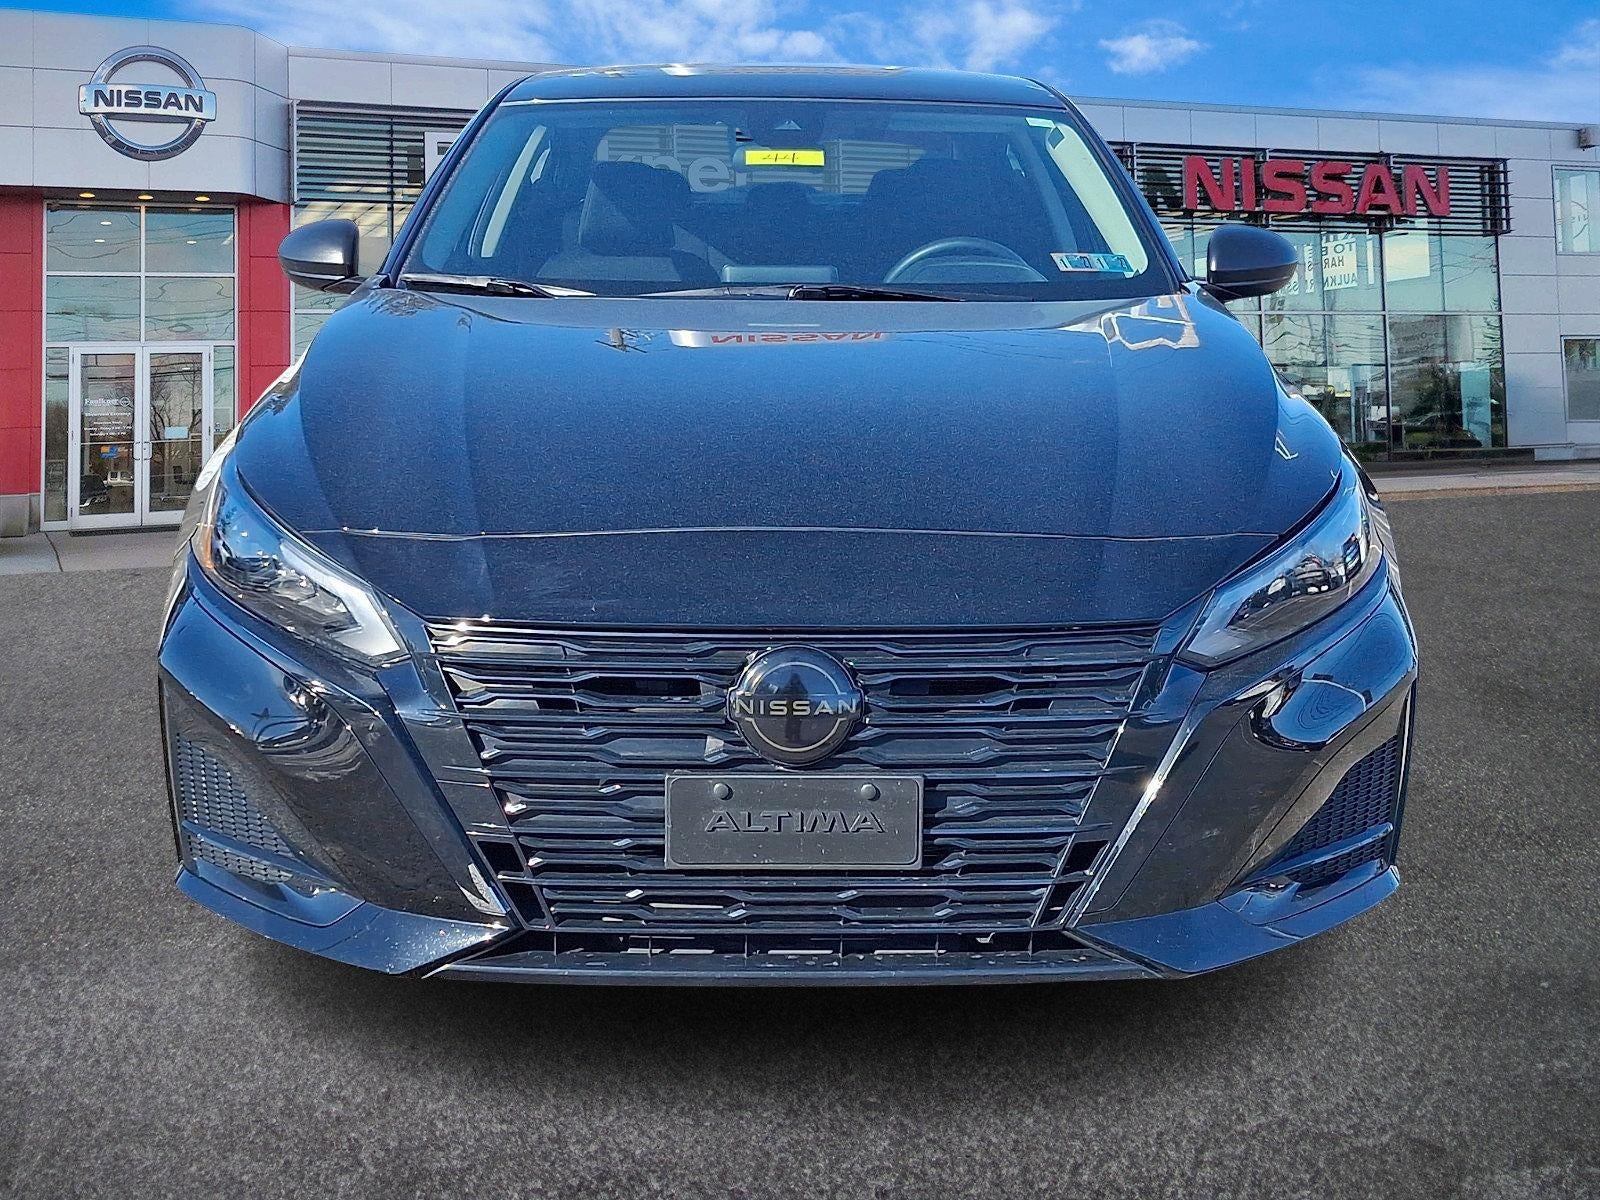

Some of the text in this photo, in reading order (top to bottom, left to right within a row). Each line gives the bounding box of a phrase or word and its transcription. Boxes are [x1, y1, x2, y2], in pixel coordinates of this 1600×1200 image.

[93, 89, 203, 113] NISSAN
[1183, 155, 1450, 216] NISSAN
[735, 698, 857, 717] NISSAN
[704, 810, 886, 834] ALTIMA
